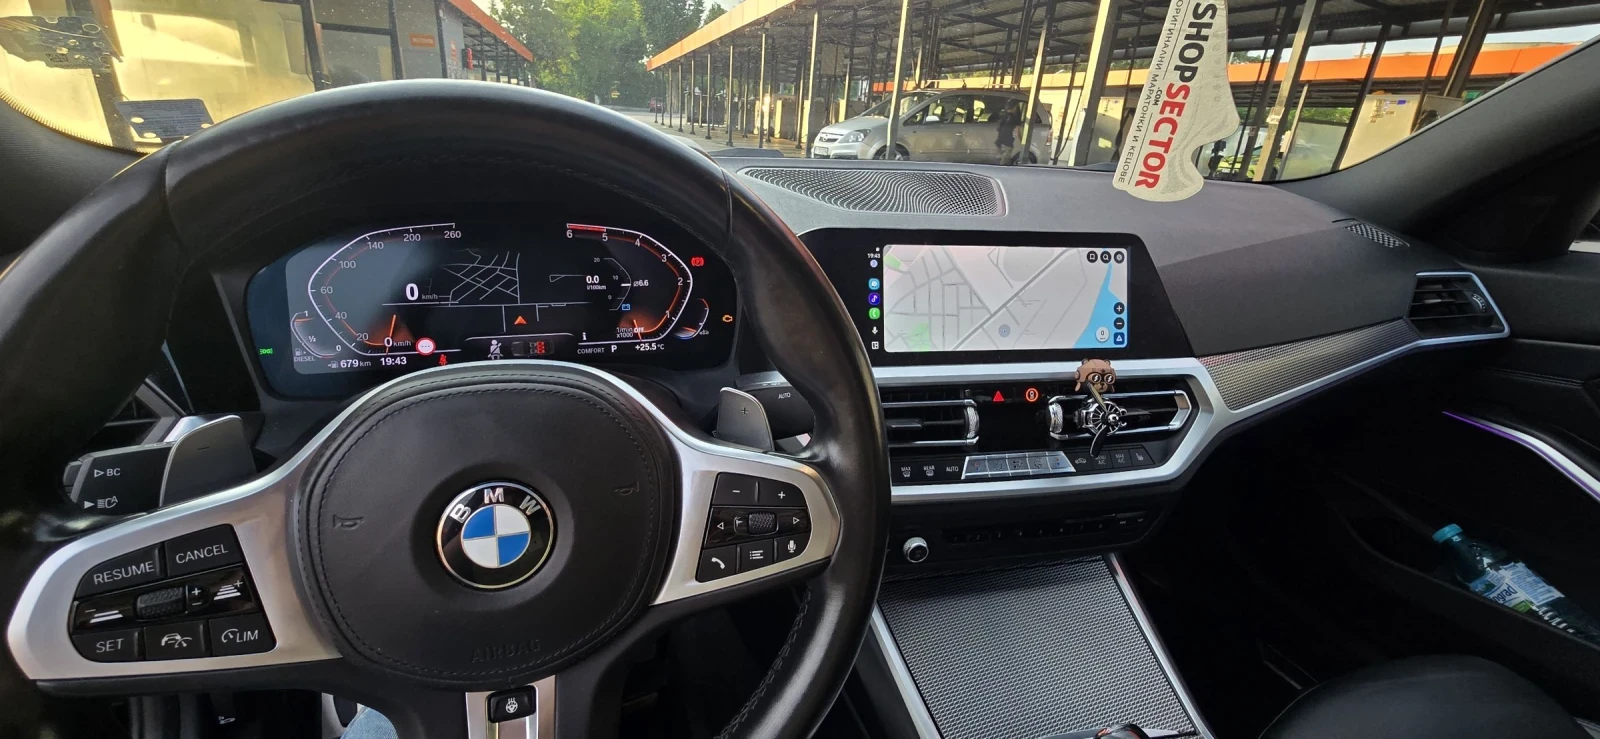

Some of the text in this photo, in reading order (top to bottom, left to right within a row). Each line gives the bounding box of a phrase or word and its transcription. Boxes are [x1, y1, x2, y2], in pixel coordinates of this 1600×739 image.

[1154, 0, 1184, 70] ОРИГИНАЛНИ
[1135, 73, 1160, 132] МАРАТОНКИ
[1118, 145, 1136, 183] КЕЦОВЕ
[403, 233, 421, 242] 200
[443, 230, 462, 239] 260
[566, 229, 573, 239] 6
[602, 232, 608, 242] 5
[367, 241, 384, 250] 140
[634, 238, 641, 247] 4
[661, 254, 667, 263] 3
[339, 260, 356, 269] 100
[586, 275, 600, 284] 0.0
[677, 277, 683, 286] 2
[320, 286, 333, 294] 60
[405, 283, 419, 301] 0
[335, 311, 347, 320] 40
[356, 332, 369, 341] 20
[384, 337, 393, 347] 0
[611, 345, 617, 353] P
[340, 359, 359, 368] 679
[380, 357, 407, 366] 19:43
[106, 468, 121, 477] BC
[175, 543, 229, 565] CANCEL
[93, 561, 155, 586] RESUME
[236, 629, 259, 643] LIM
[95, 638, 125, 653] SET
[471, 639, 541, 664] AIRBAG
